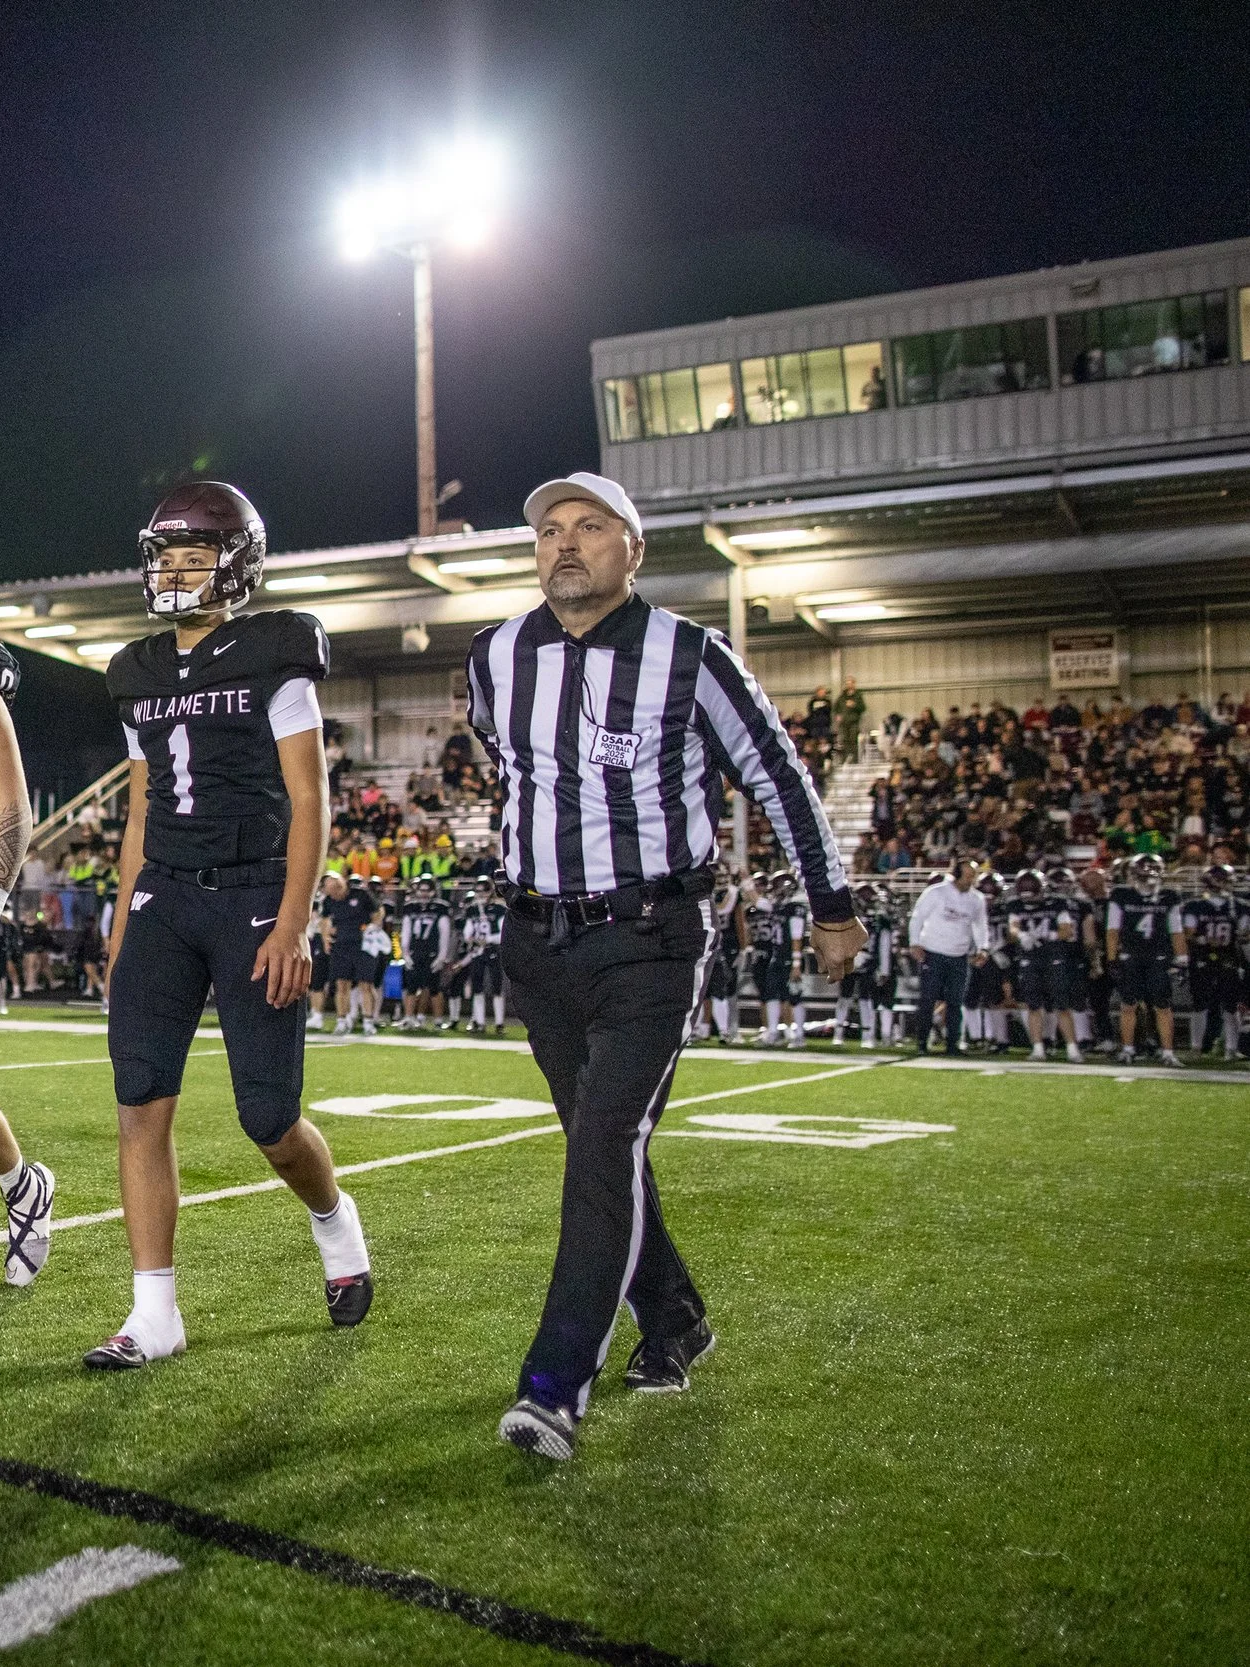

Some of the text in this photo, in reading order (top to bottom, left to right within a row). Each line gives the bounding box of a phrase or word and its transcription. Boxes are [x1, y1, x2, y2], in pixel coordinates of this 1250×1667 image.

[134, 689, 251, 724] WILLAMETTE
[601, 734, 633, 747] OSAA
[600, 742, 630, 753] FOOTBALL
[604, 749, 625, 759] 2025
[595, 754, 629, 767] OFFICIAL
[167, 723, 194, 815] 1
[1135, 912, 1154, 940] 4
